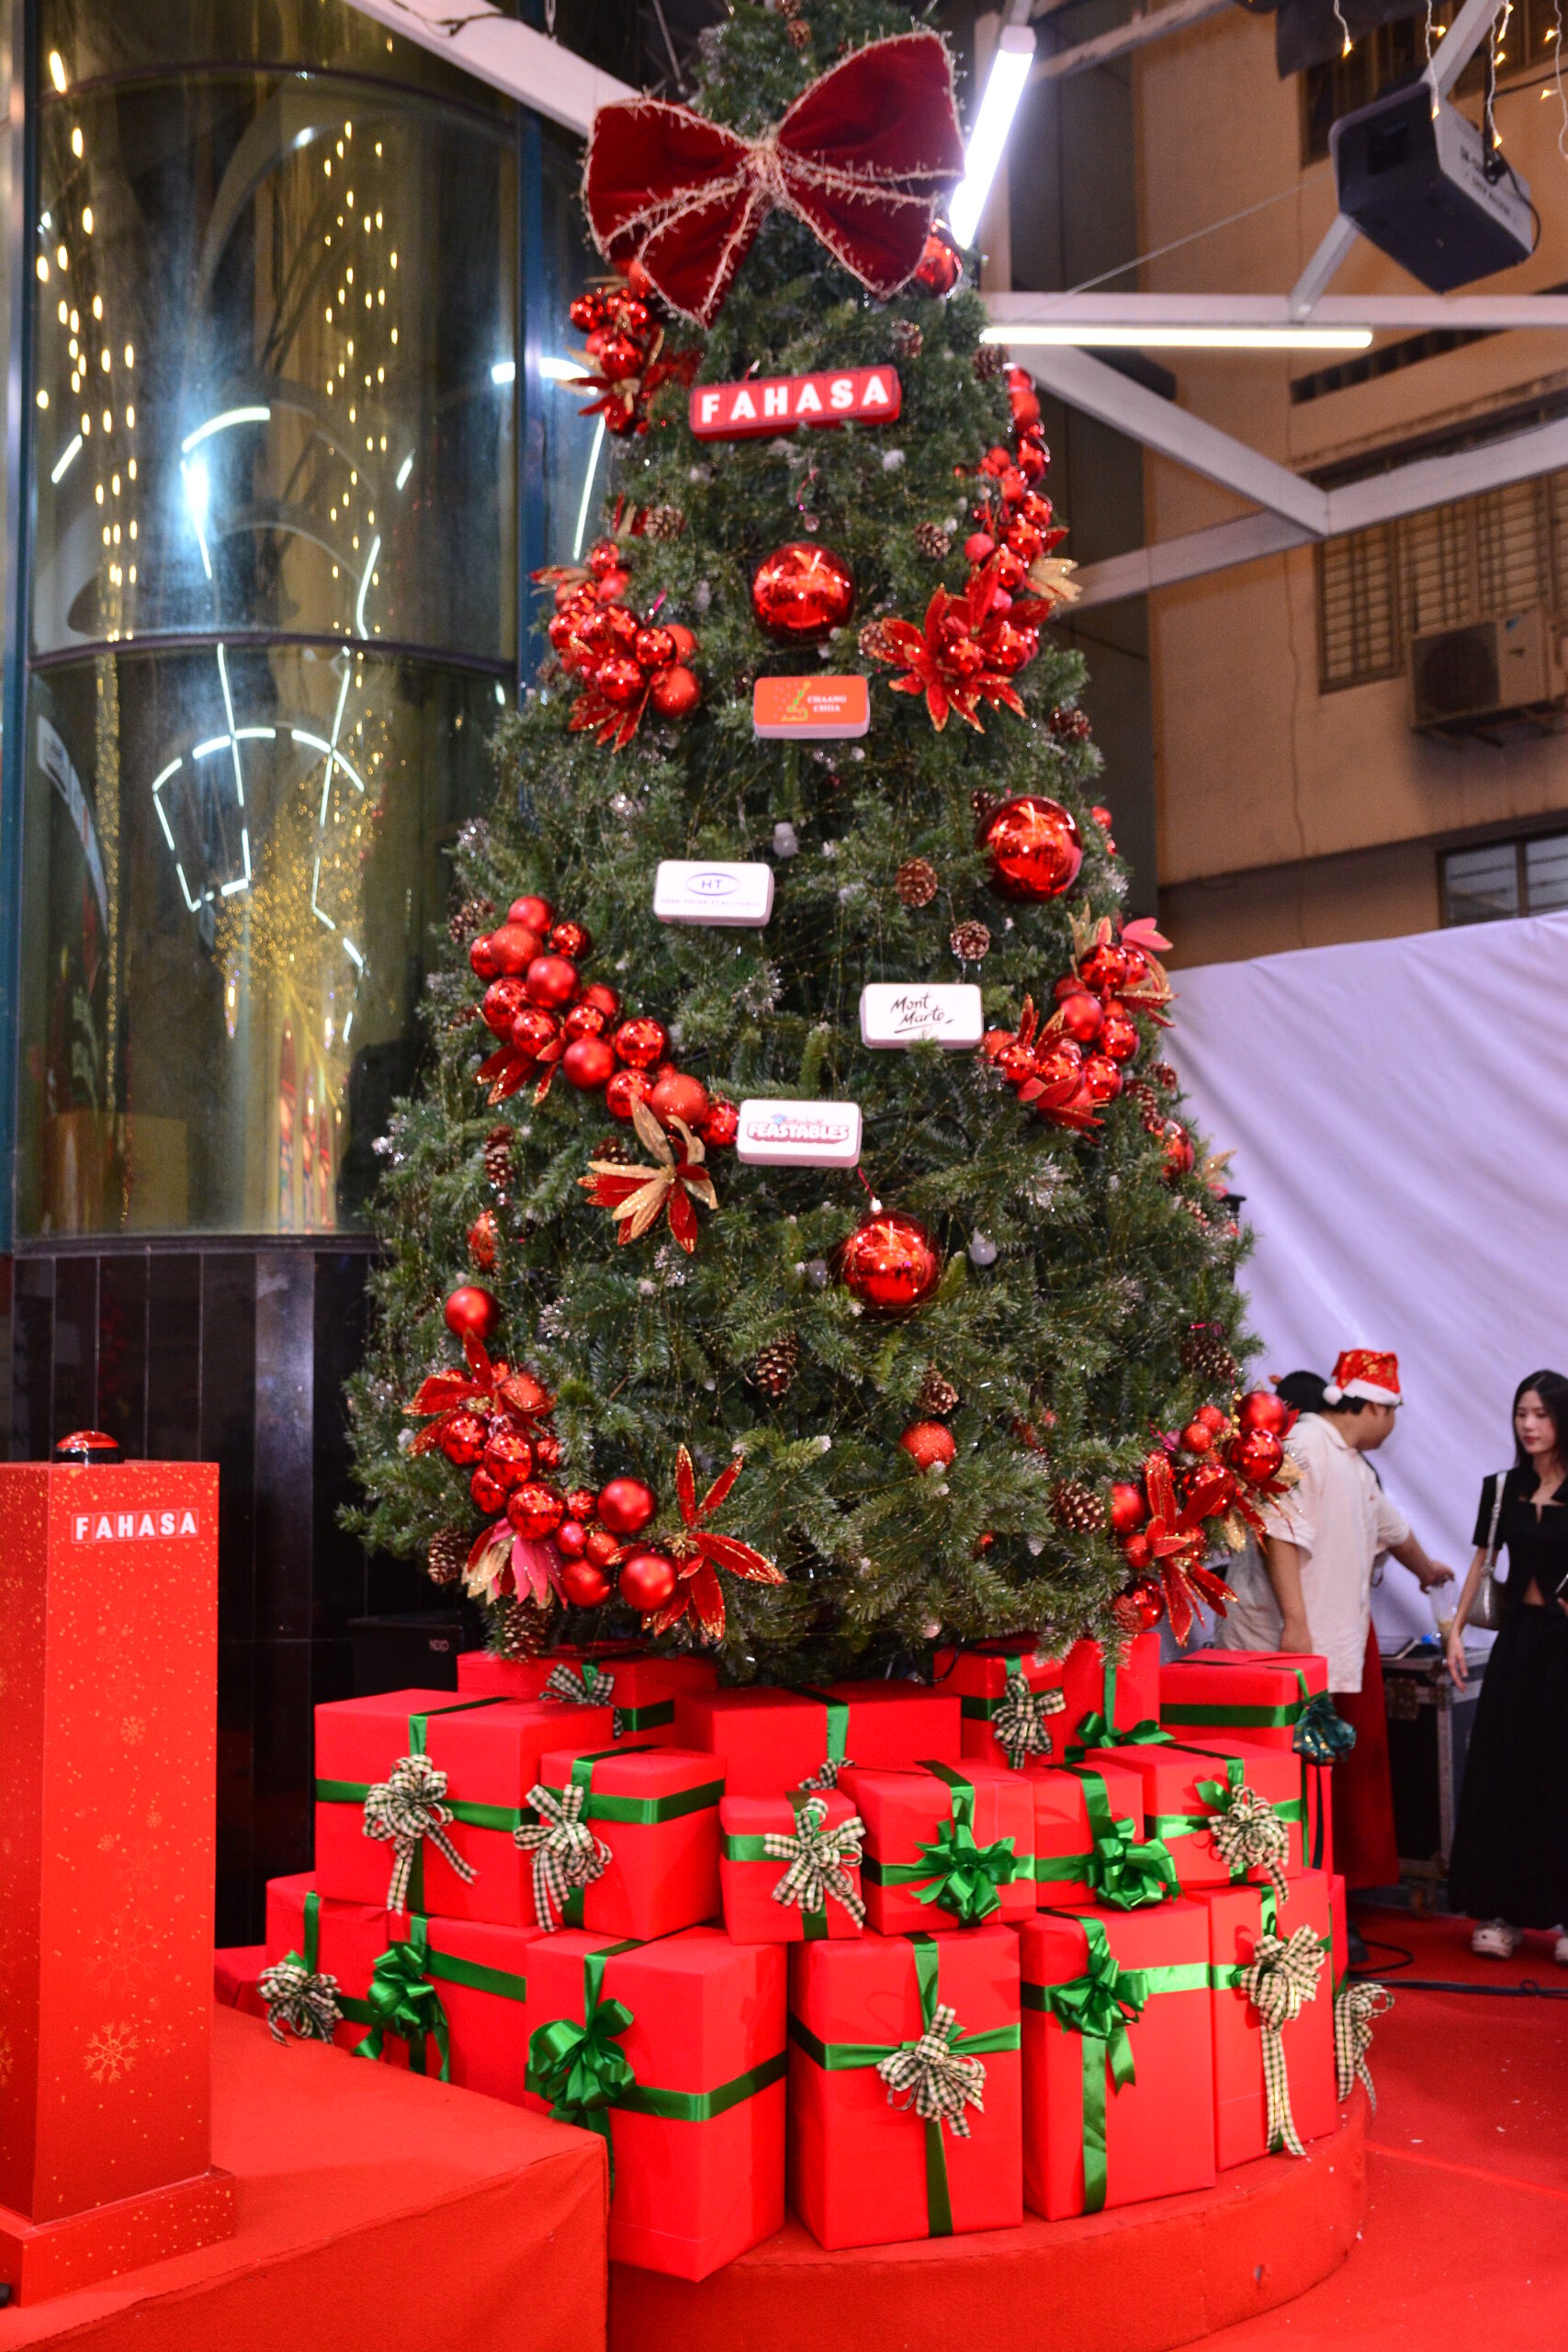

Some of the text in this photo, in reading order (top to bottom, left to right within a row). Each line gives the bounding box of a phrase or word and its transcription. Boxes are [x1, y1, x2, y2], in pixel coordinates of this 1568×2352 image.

[701, 375, 889, 424] FAHASA
[701, 878, 723, 890] HT
[890, 990, 931, 1013] Mont
[898, 1005, 945, 1026] Marte
[747, 1122, 850, 1143] FEASTABLES
[75, 1511, 197, 1541] FAHASA
